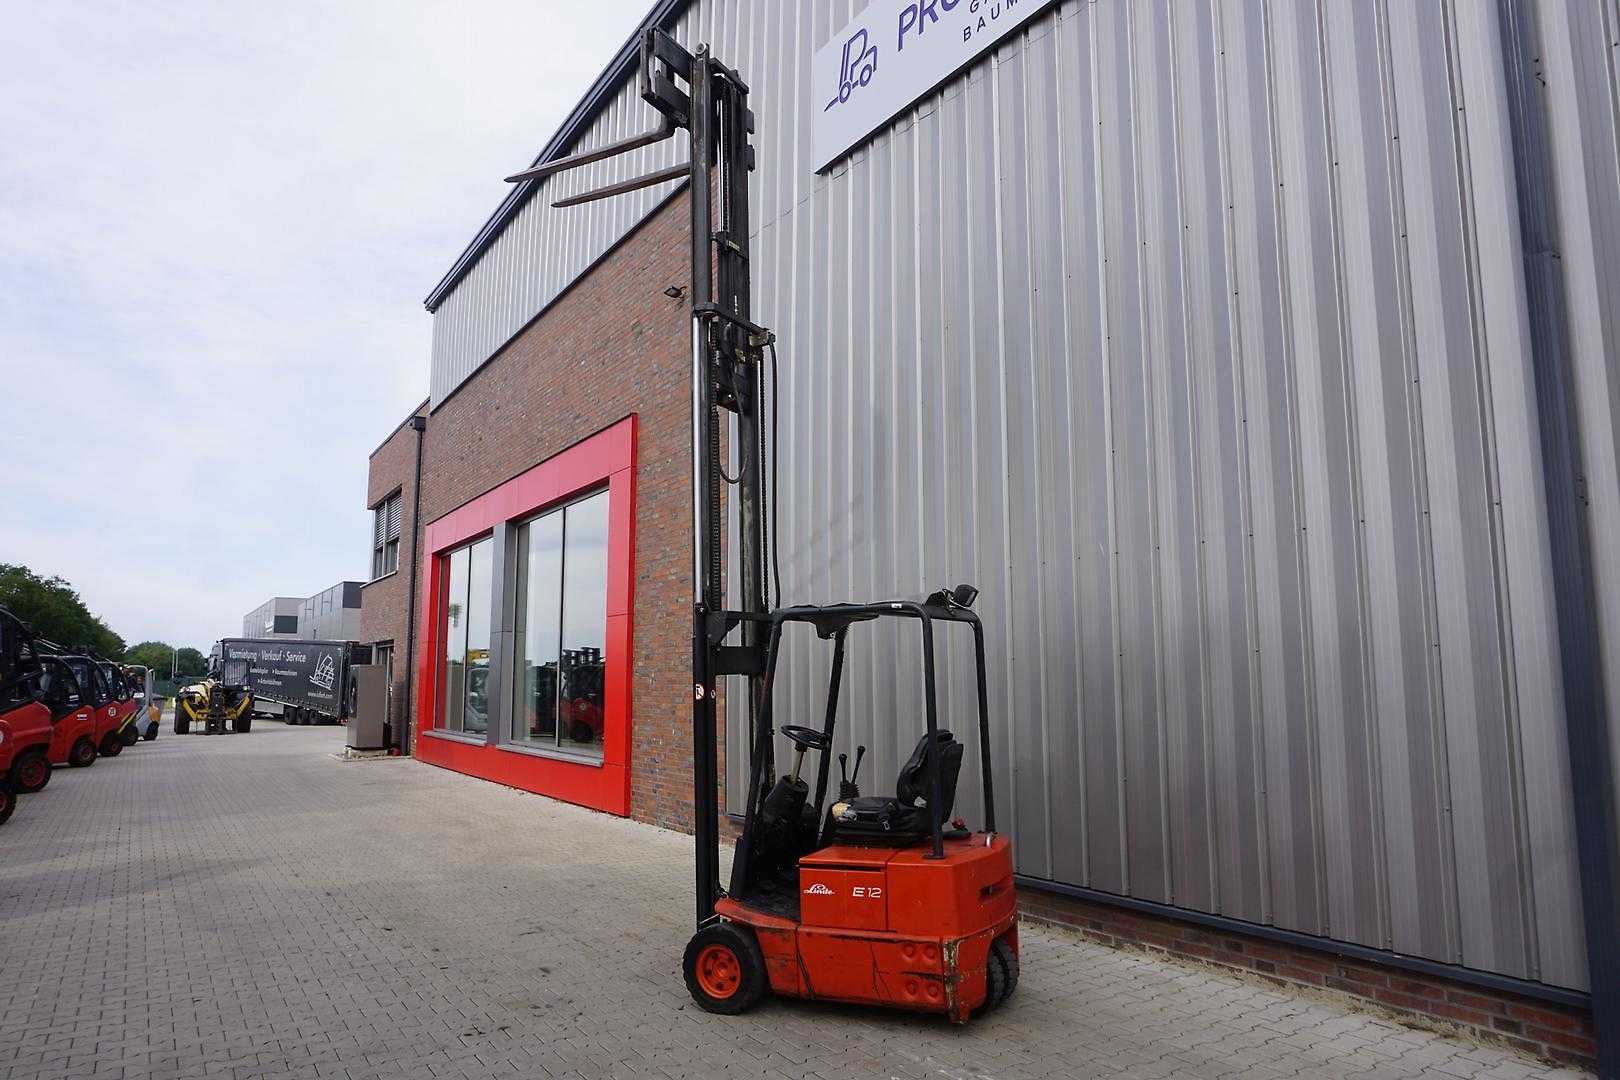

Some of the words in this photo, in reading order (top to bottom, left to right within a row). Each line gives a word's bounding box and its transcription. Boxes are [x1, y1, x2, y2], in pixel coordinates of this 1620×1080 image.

[261, 649, 283, 661] Verkauf
[286, 651, 306, 663] Service
[803, 883, 836, 896] Linde
